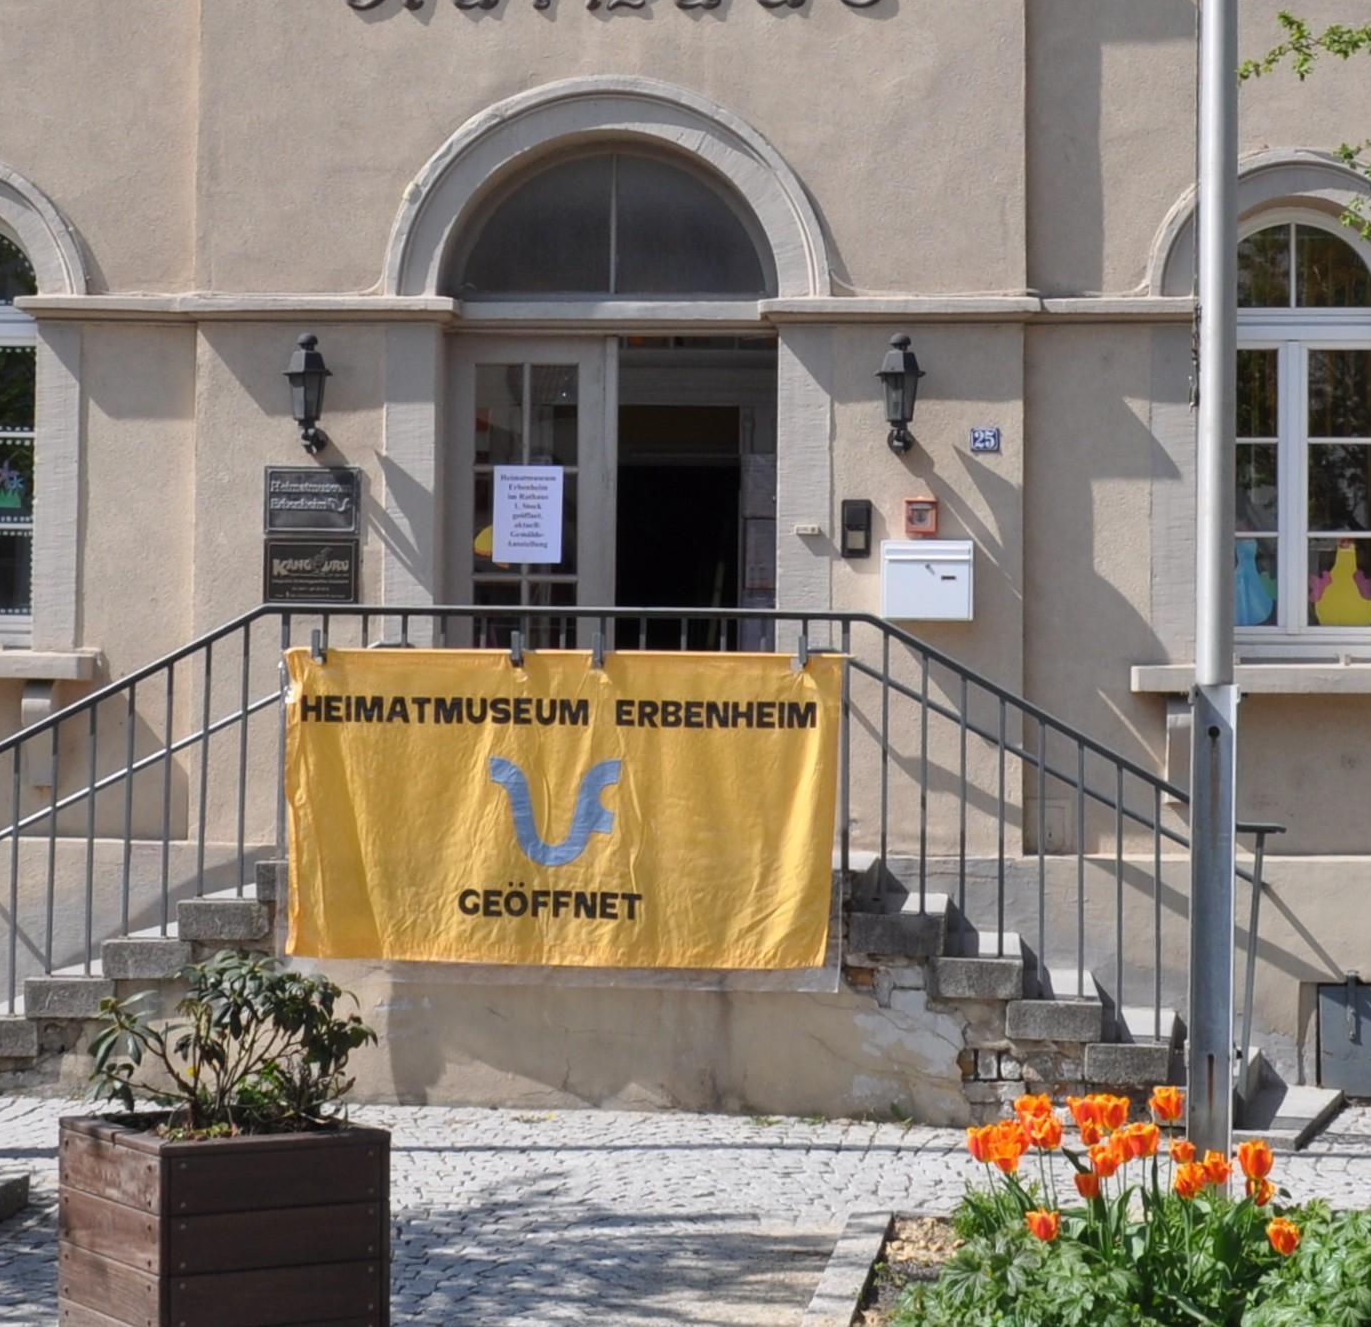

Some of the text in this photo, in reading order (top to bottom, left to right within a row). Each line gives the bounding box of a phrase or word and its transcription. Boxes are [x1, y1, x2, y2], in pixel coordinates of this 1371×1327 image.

[974, 429, 995, 449] 25
[500, 474, 556, 482] Heimatmuseum
[301, 695, 817, 729] HEIMATMUSEUM ERBENHEIM
[458, 881, 643, 921] GEÖFFNET
